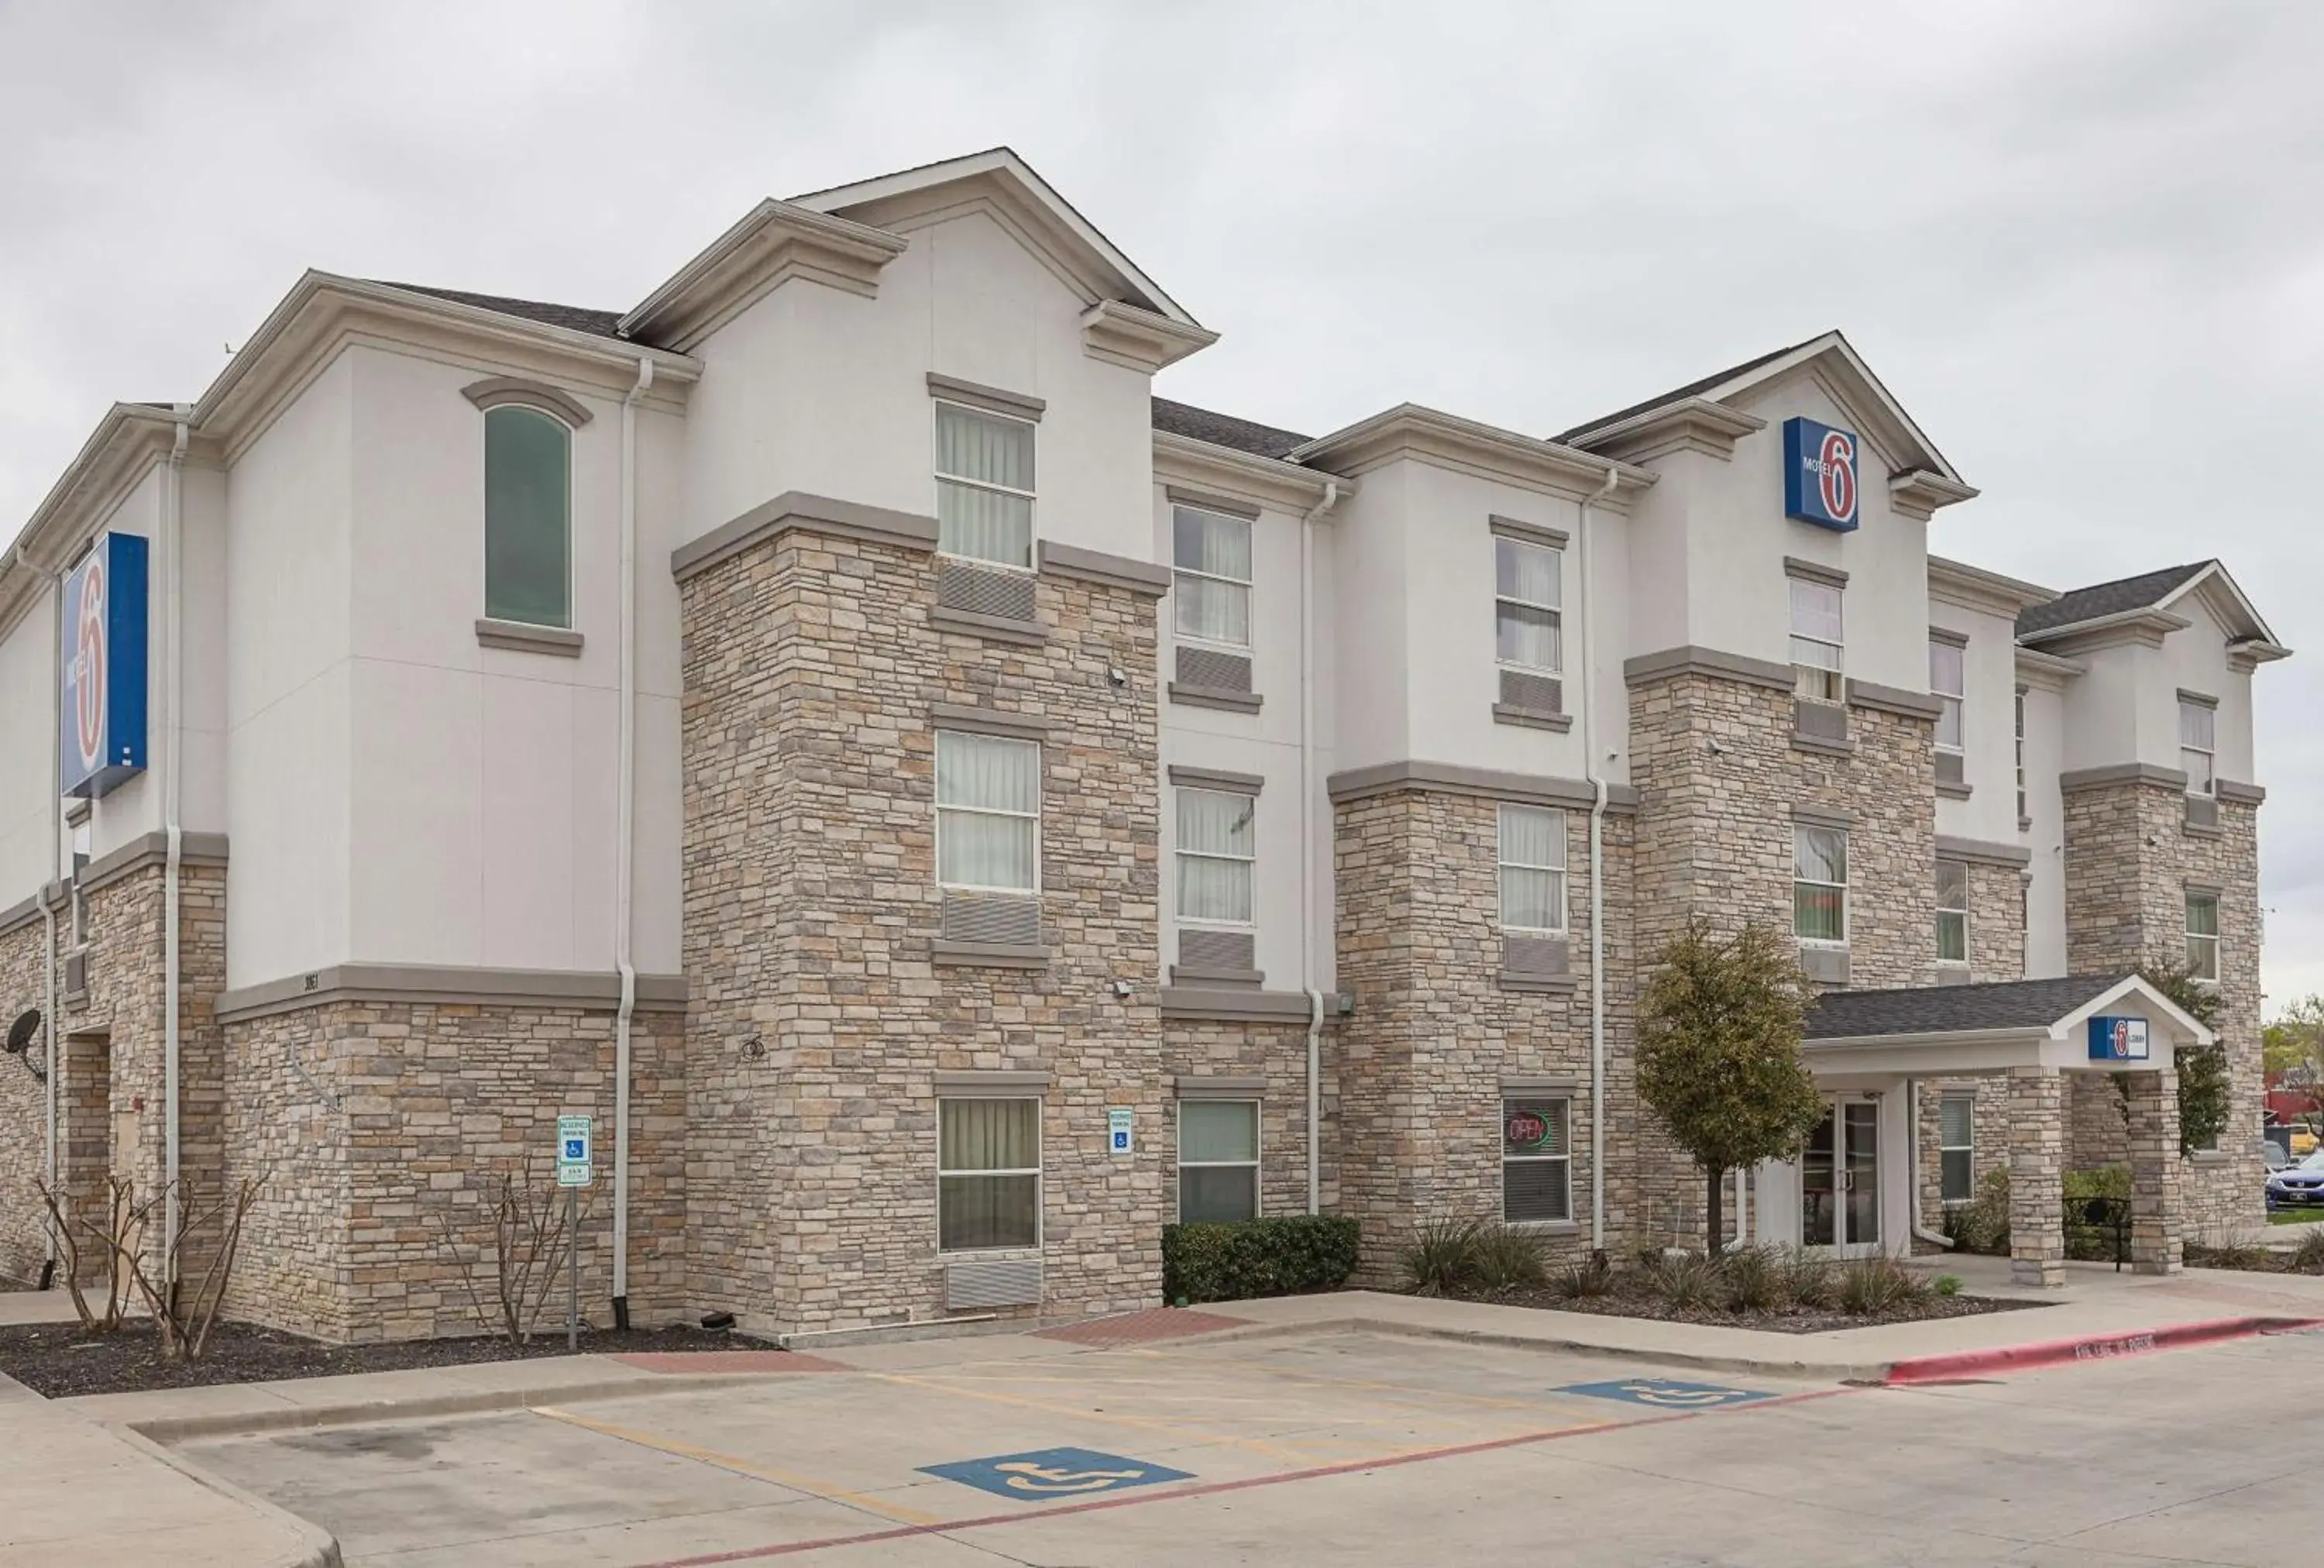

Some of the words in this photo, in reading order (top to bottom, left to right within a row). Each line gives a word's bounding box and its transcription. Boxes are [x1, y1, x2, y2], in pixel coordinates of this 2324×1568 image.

[1803, 456, 1831, 477] MOTEL
[1820, 431, 1856, 522] 6
[78, 555, 104, 772] 6
